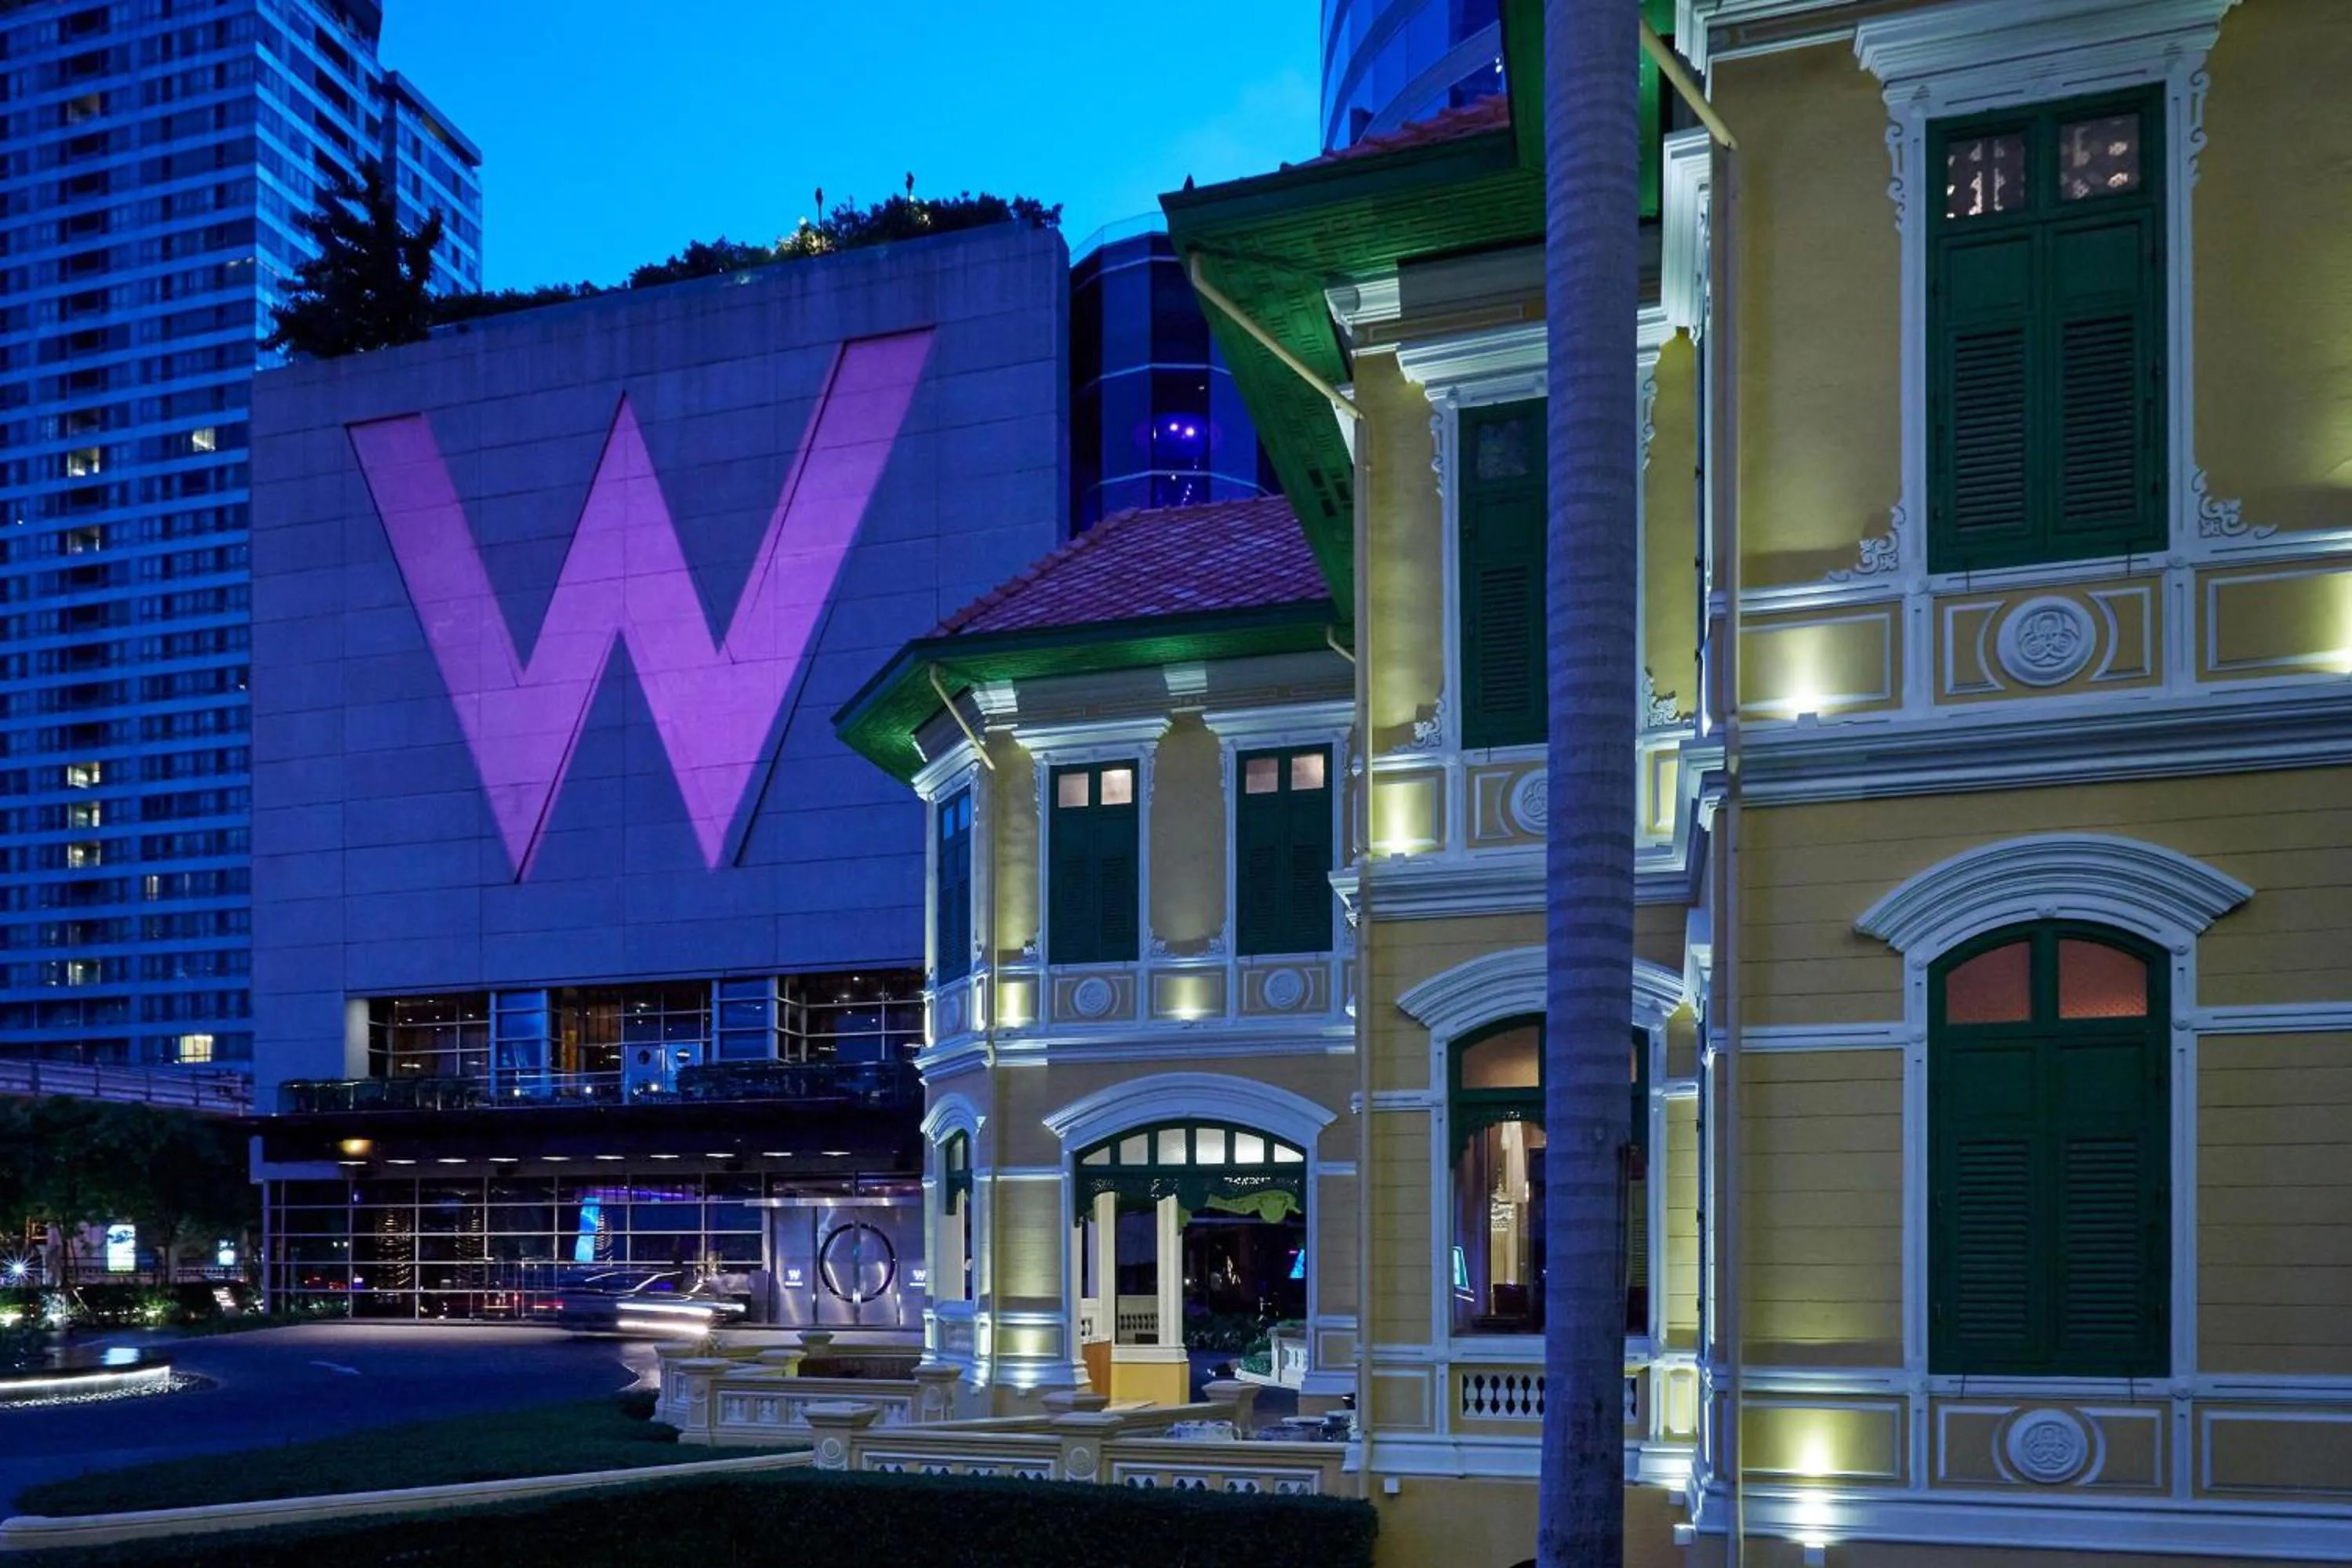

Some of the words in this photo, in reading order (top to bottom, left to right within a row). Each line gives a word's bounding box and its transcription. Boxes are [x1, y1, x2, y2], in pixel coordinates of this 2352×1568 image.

[345, 325, 937, 884] W
[788, 1269, 800, 1279] W
[913, 1269, 926, 1280] W
